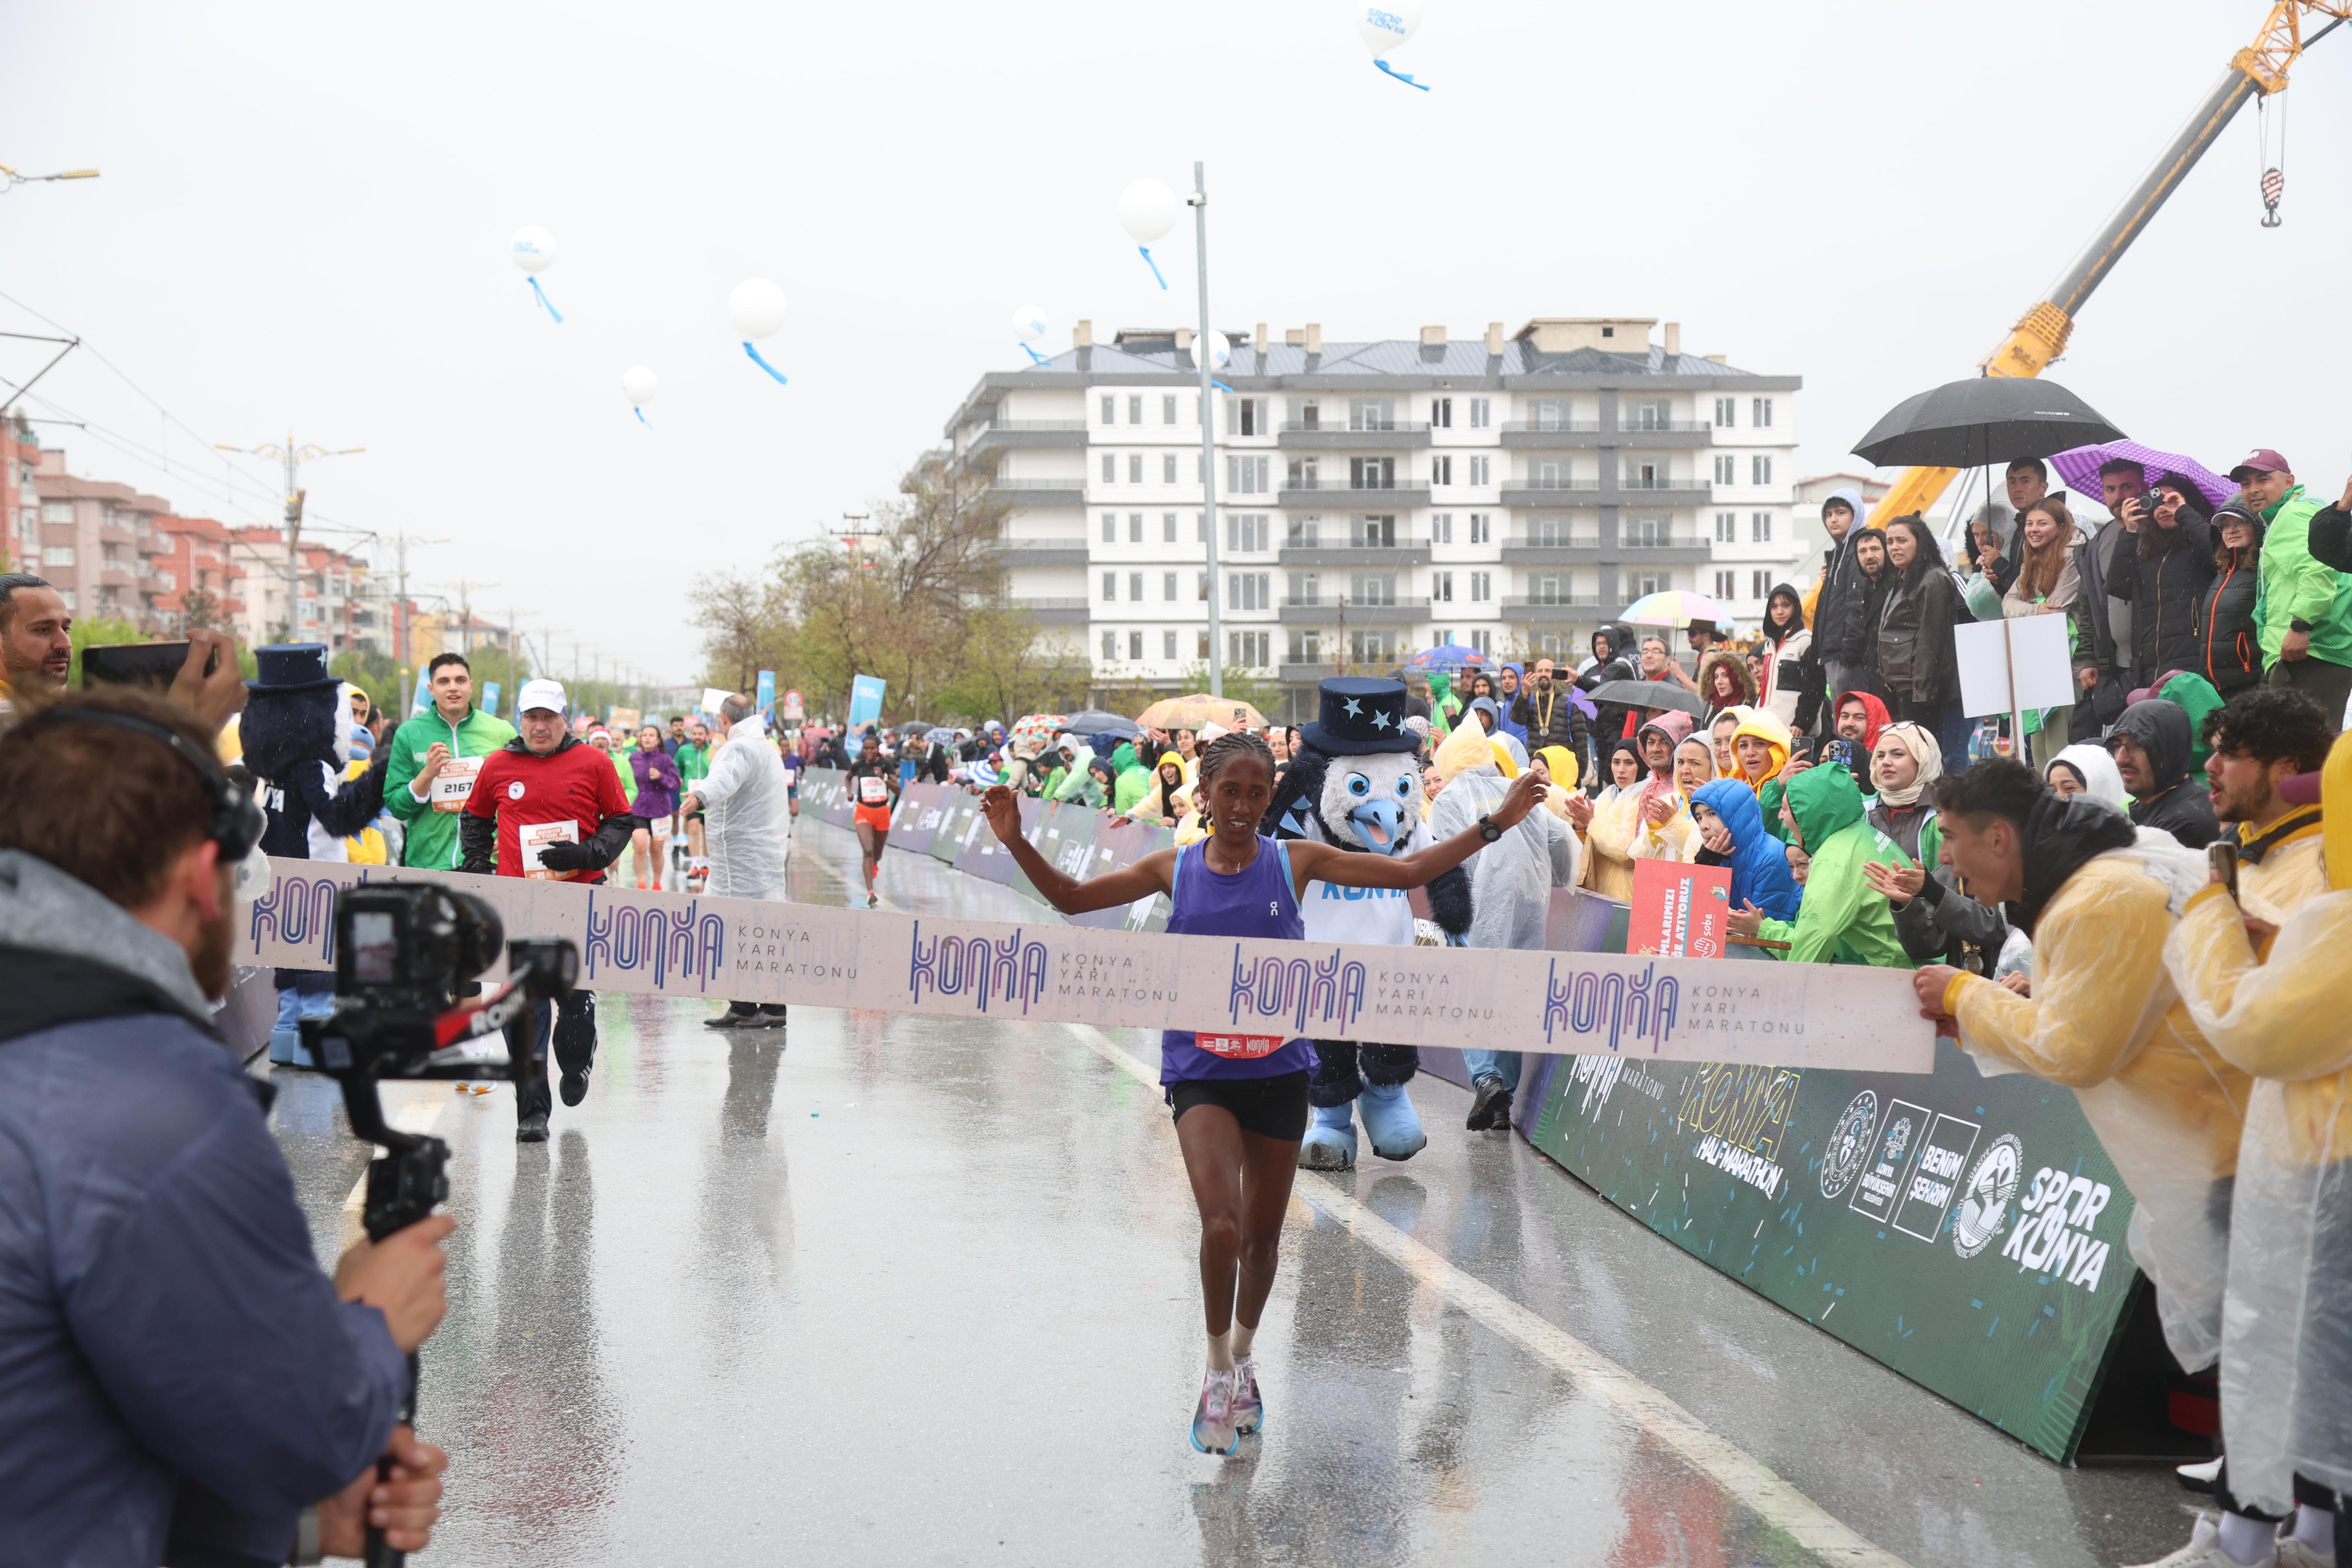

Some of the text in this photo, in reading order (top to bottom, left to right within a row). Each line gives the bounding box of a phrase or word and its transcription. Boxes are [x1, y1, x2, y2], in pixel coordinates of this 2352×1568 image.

[1367, 7, 1402, 24] SPOR
[1367, 16, 1406, 34] KONYA
[444, 782, 473, 793] 2167
[251, 869, 368, 964] KON
[1675, 877, 1690, 941] ATIYORUZ
[1701, 913, 1713, 937] sobe
[738, 925, 810, 943] KONYA
[737, 944, 786, 957] YARI
[1062, 952, 1132, 968] KONYA
[736, 960, 858, 979] MARATONU
[1061, 968, 1108, 982] YARI
[1380, 971, 1449, 985] KONYA
[1058, 985, 1179, 1002] MARATONU
[1378, 987, 1425, 1001] YARI
[1692, 986, 1760, 999] KONYA
[1376, 1004, 1494, 1020] MARATONU
[1691, 1002, 1736, 1014] YARI
[1688, 1019, 1805, 1035] MARATONU
[1621, 1066, 1665, 1100] MARATONU
[1696, 1133, 1729, 1166] HALF
[1719, 1143, 1784, 1194] MARATHON
[1920, 1144, 1965, 1180] BENİM
[1909, 1176, 1951, 1208] ŞEHRİM
[2022, 1167, 2111, 1232] SPOR
[2001, 1206, 2110, 1293] KONYA
